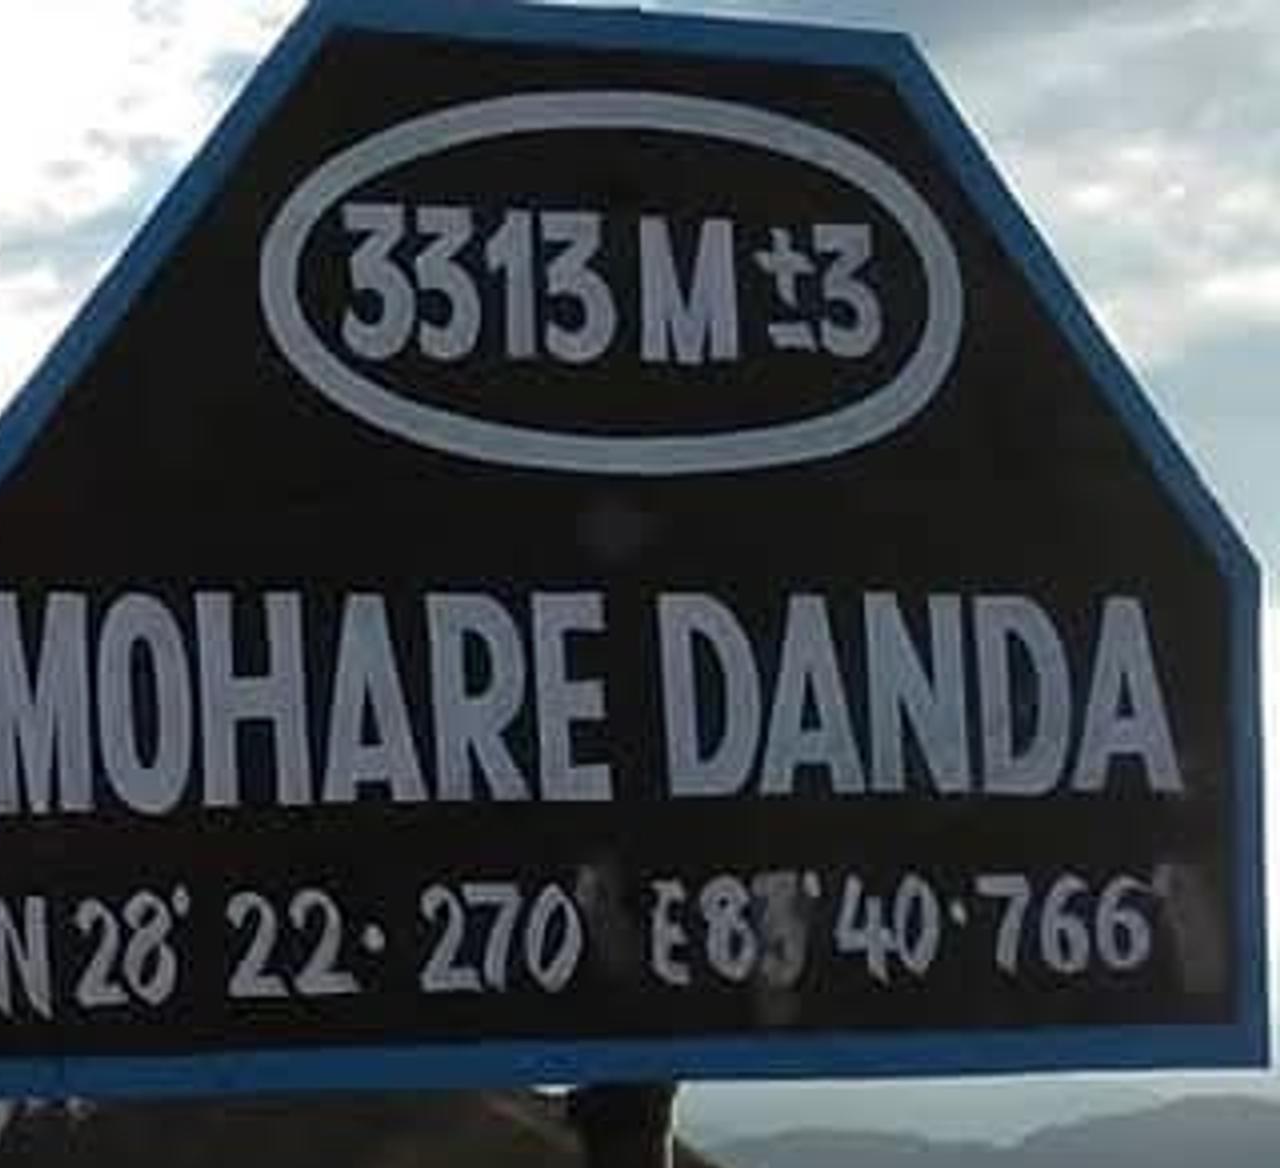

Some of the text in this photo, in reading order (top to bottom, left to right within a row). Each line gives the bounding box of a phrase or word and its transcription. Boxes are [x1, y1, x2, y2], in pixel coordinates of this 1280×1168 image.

[341, 201, 618, 363] 3313
[638, 215, 739, 364] M
[657, 590, 1186, 796] DANDA
